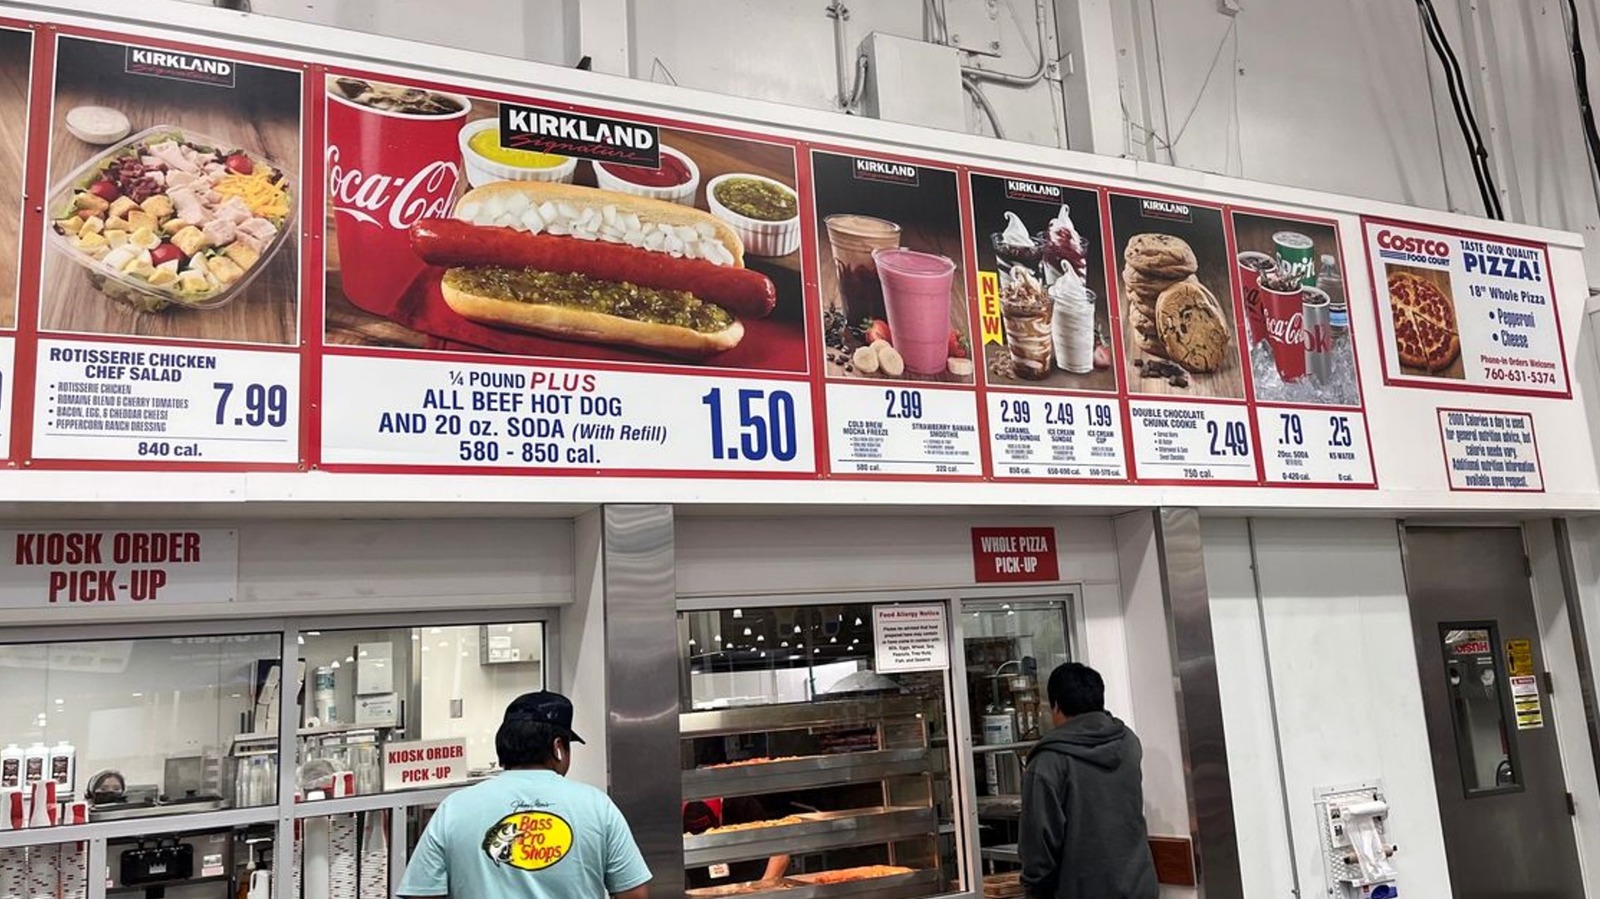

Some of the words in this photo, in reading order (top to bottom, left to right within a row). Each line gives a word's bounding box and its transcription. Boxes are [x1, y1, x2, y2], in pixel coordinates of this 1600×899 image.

[133, 49, 231, 76] KIRKLAND
[508, 109, 654, 150] KIRKLAND
[509, 133, 657, 161] Signature
[857, 159, 915, 177] KIRKLAND
[1008, 180, 1060, 197] KIRKLAND
[1142, 199, 1189, 215] KIRKLAND
[1377, 229, 1449, 257] COSTCO
[1460, 240, 1484, 253] TASTE
[1486, 244, 1504, 256] OUR
[1506, 246, 1539, 261] QUALITY
[1407, 253, 1427, 265] FOOD
[1428, 256, 1450, 267] COURT
[1463, 252, 1542, 282] PIZZA!
[1489, 287, 1519, 302] Whole
[1521, 290, 1546, 305] Pizza
[981, 277, 1000, 335] NEW
[1497, 308, 1536, 329] Pepperoni
[1501, 329, 1529, 348] Cheese
[50, 347, 145, 366] ROTISSERIE
[149, 352, 216, 369] CHICKEN
[1509, 357, 1529, 368] Orders
[1530, 359, 1556, 369] Welcome
[85, 364, 125, 380] CHEF
[129, 366, 182, 382] SALAD
[469, 372, 526, 390] POUND
[530, 371, 597, 392] PLUS
[1484, 367, 1556, 385] 760-631-5374
[58, 382, 99, 393] ROTISSERIE
[100, 383, 132, 394] CHICKEN
[57, 394, 91, 405] ROMAINE
[92, 395, 115, 406] BLEND
[122, 396, 150, 408] CHERRY
[152, 397, 189, 409] TOMATOES
[213, 382, 288, 427] 7.99
[423, 388, 464, 410] ALL
[472, 391, 524, 413] BEEF
[531, 394, 573, 415] HOT
[580, 396, 622, 417] DOG
[885, 390, 922, 419] 2.99
[56, 406, 84, 418] BACON,
[109, 408, 142, 419] CHEDDAR
[143, 409, 168, 420] CHEESE
[1000, 400, 1031, 423] 2.99
[1044, 402, 1074, 425] 2.49
[1085, 404, 1112, 427] 1.99
[1132, 407, 1162, 418] DOUBLE
[1163, 408, 1205, 420] CHOCOLATE
[56, 419, 103, 430] PEPPERCORN
[104, 420, 130, 431] RANCH
[130, 421, 166, 432] DRESSING
[378, 412, 427, 434] AND
[435, 414, 462, 435] 20
[469, 419, 498, 437] oz.
[507, 417, 565, 438] SODA
[572, 421, 616, 443] (With
[619, 423, 667, 445] Refill)
[702, 387, 797, 461] 1.50
[843, 427, 865, 435] MOCHA
[866, 428, 889, 436] FREEZE
[848, 420, 864, 428] COLD
[865, 421, 883, 429] BREW
[912, 423, 950, 431] STRAWBERRY
[952, 424, 975, 432] BANANA
[1143, 418, 1169, 428] CHUNK
[1170, 419, 1197, 429] COOKIE
[1278, 413, 1304, 445] .79
[1328, 416, 1352, 447] .25
[995, 433, 1018, 441] CHURRO
[1206, 420, 1249, 456] 2.49
[138, 442, 170, 456] 840
[174, 442, 202, 457] cal.
[459, 440, 499, 461] 580
[521, 441, 560, 462] 850
[566, 443, 601, 464] cal.
[1293, 450, 1309, 459] SODA
[1339, 452, 1355, 460] WATER
[1183, 468, 1198, 478] 750
[1199, 468, 1214, 478] cal.
[16, 533, 102, 565] KIOSK
[113, 532, 201, 564] ORDER
[981, 536, 1017, 553] WHOLE
[1019, 536, 1048, 552] PIZZA
[995, 556, 1037, 573] PICK-UP
[49, 569, 167, 603] PICK-UP
[388, 749, 424, 764] KIOSK
[426, 745, 463, 760] ORDER
[519, 815, 553, 831] Bass
[517, 832, 545, 846] Pro
[520, 844, 562, 863] Shops
